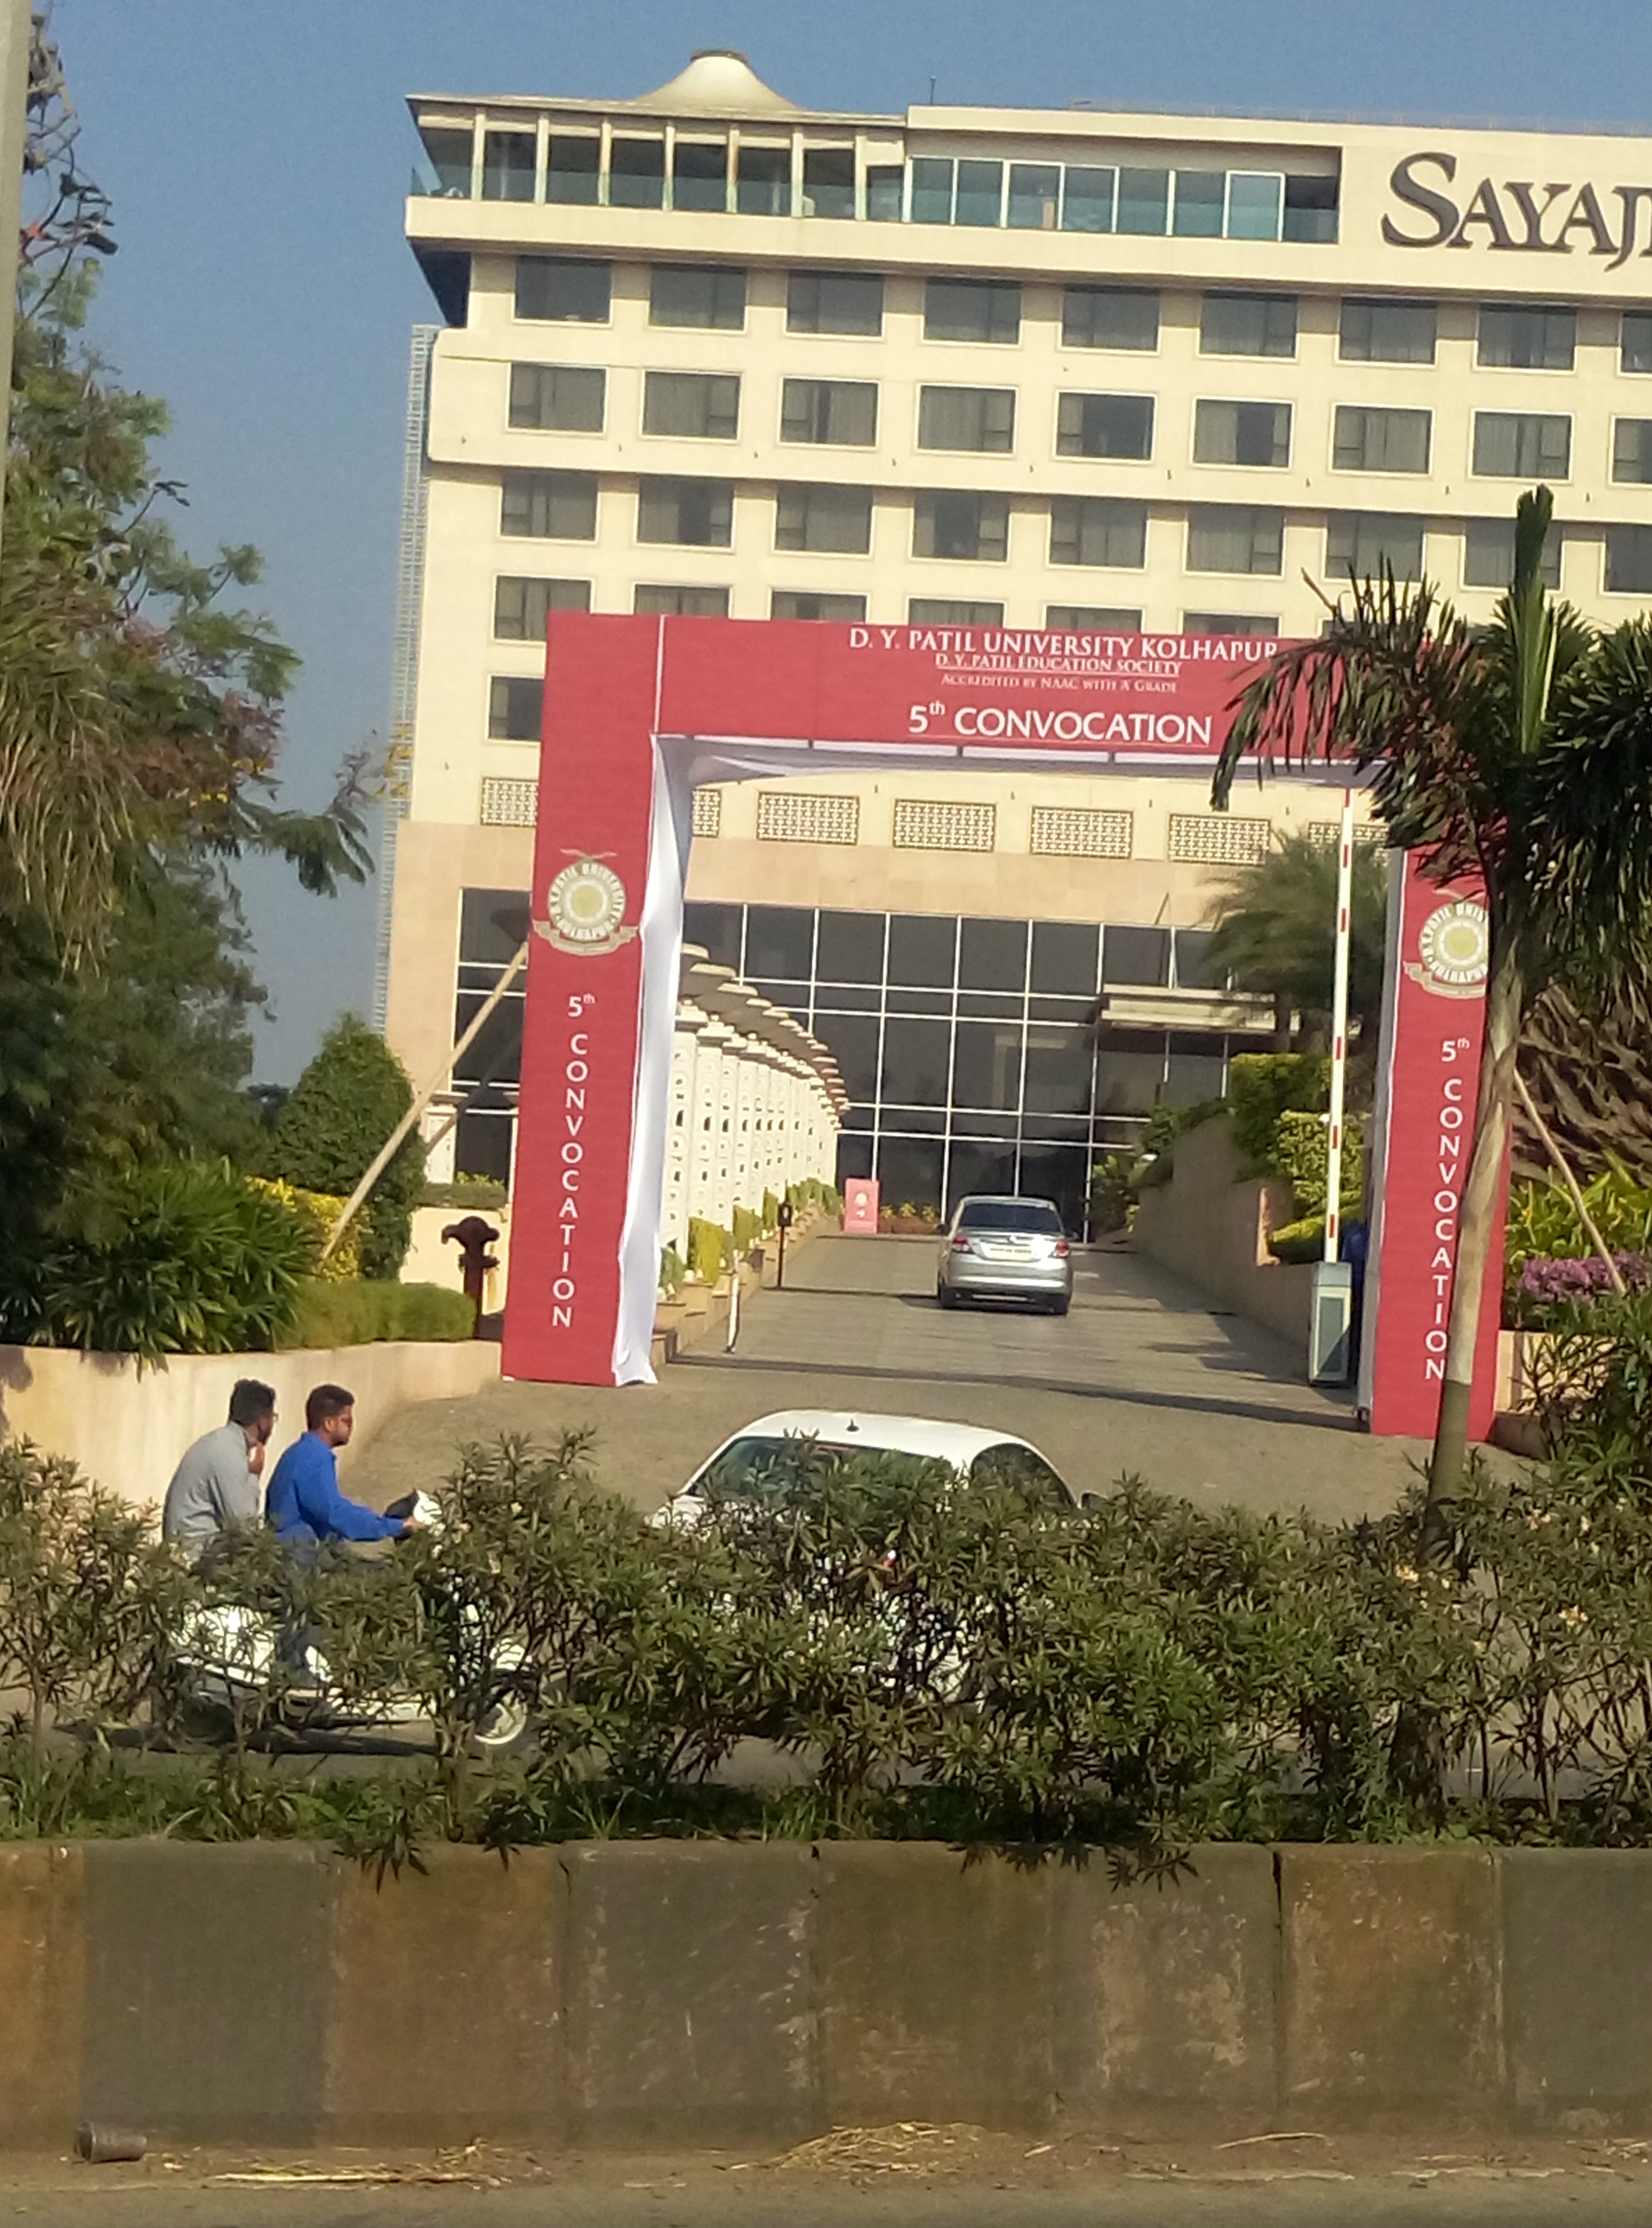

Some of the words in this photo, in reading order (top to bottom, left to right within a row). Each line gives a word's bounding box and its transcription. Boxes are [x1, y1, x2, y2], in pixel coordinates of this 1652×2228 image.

[850, 628, 874, 649] D.
[881, 628, 901, 650] Y.
[909, 630, 976, 653] PATIL
[983, 632, 1135, 657] UNIVERSITY
[972, 654, 1011, 669] PATIL
[1017, 656, 1112, 672] EDUCATION
[1116, 659, 1182, 675] SOCIETY
[908, 700, 946, 733] 5th
[954, 707, 1212, 744] CONVOCATION
[568, 993, 596, 1018] 5th
[1441, 1037, 1471, 1062] 5th
